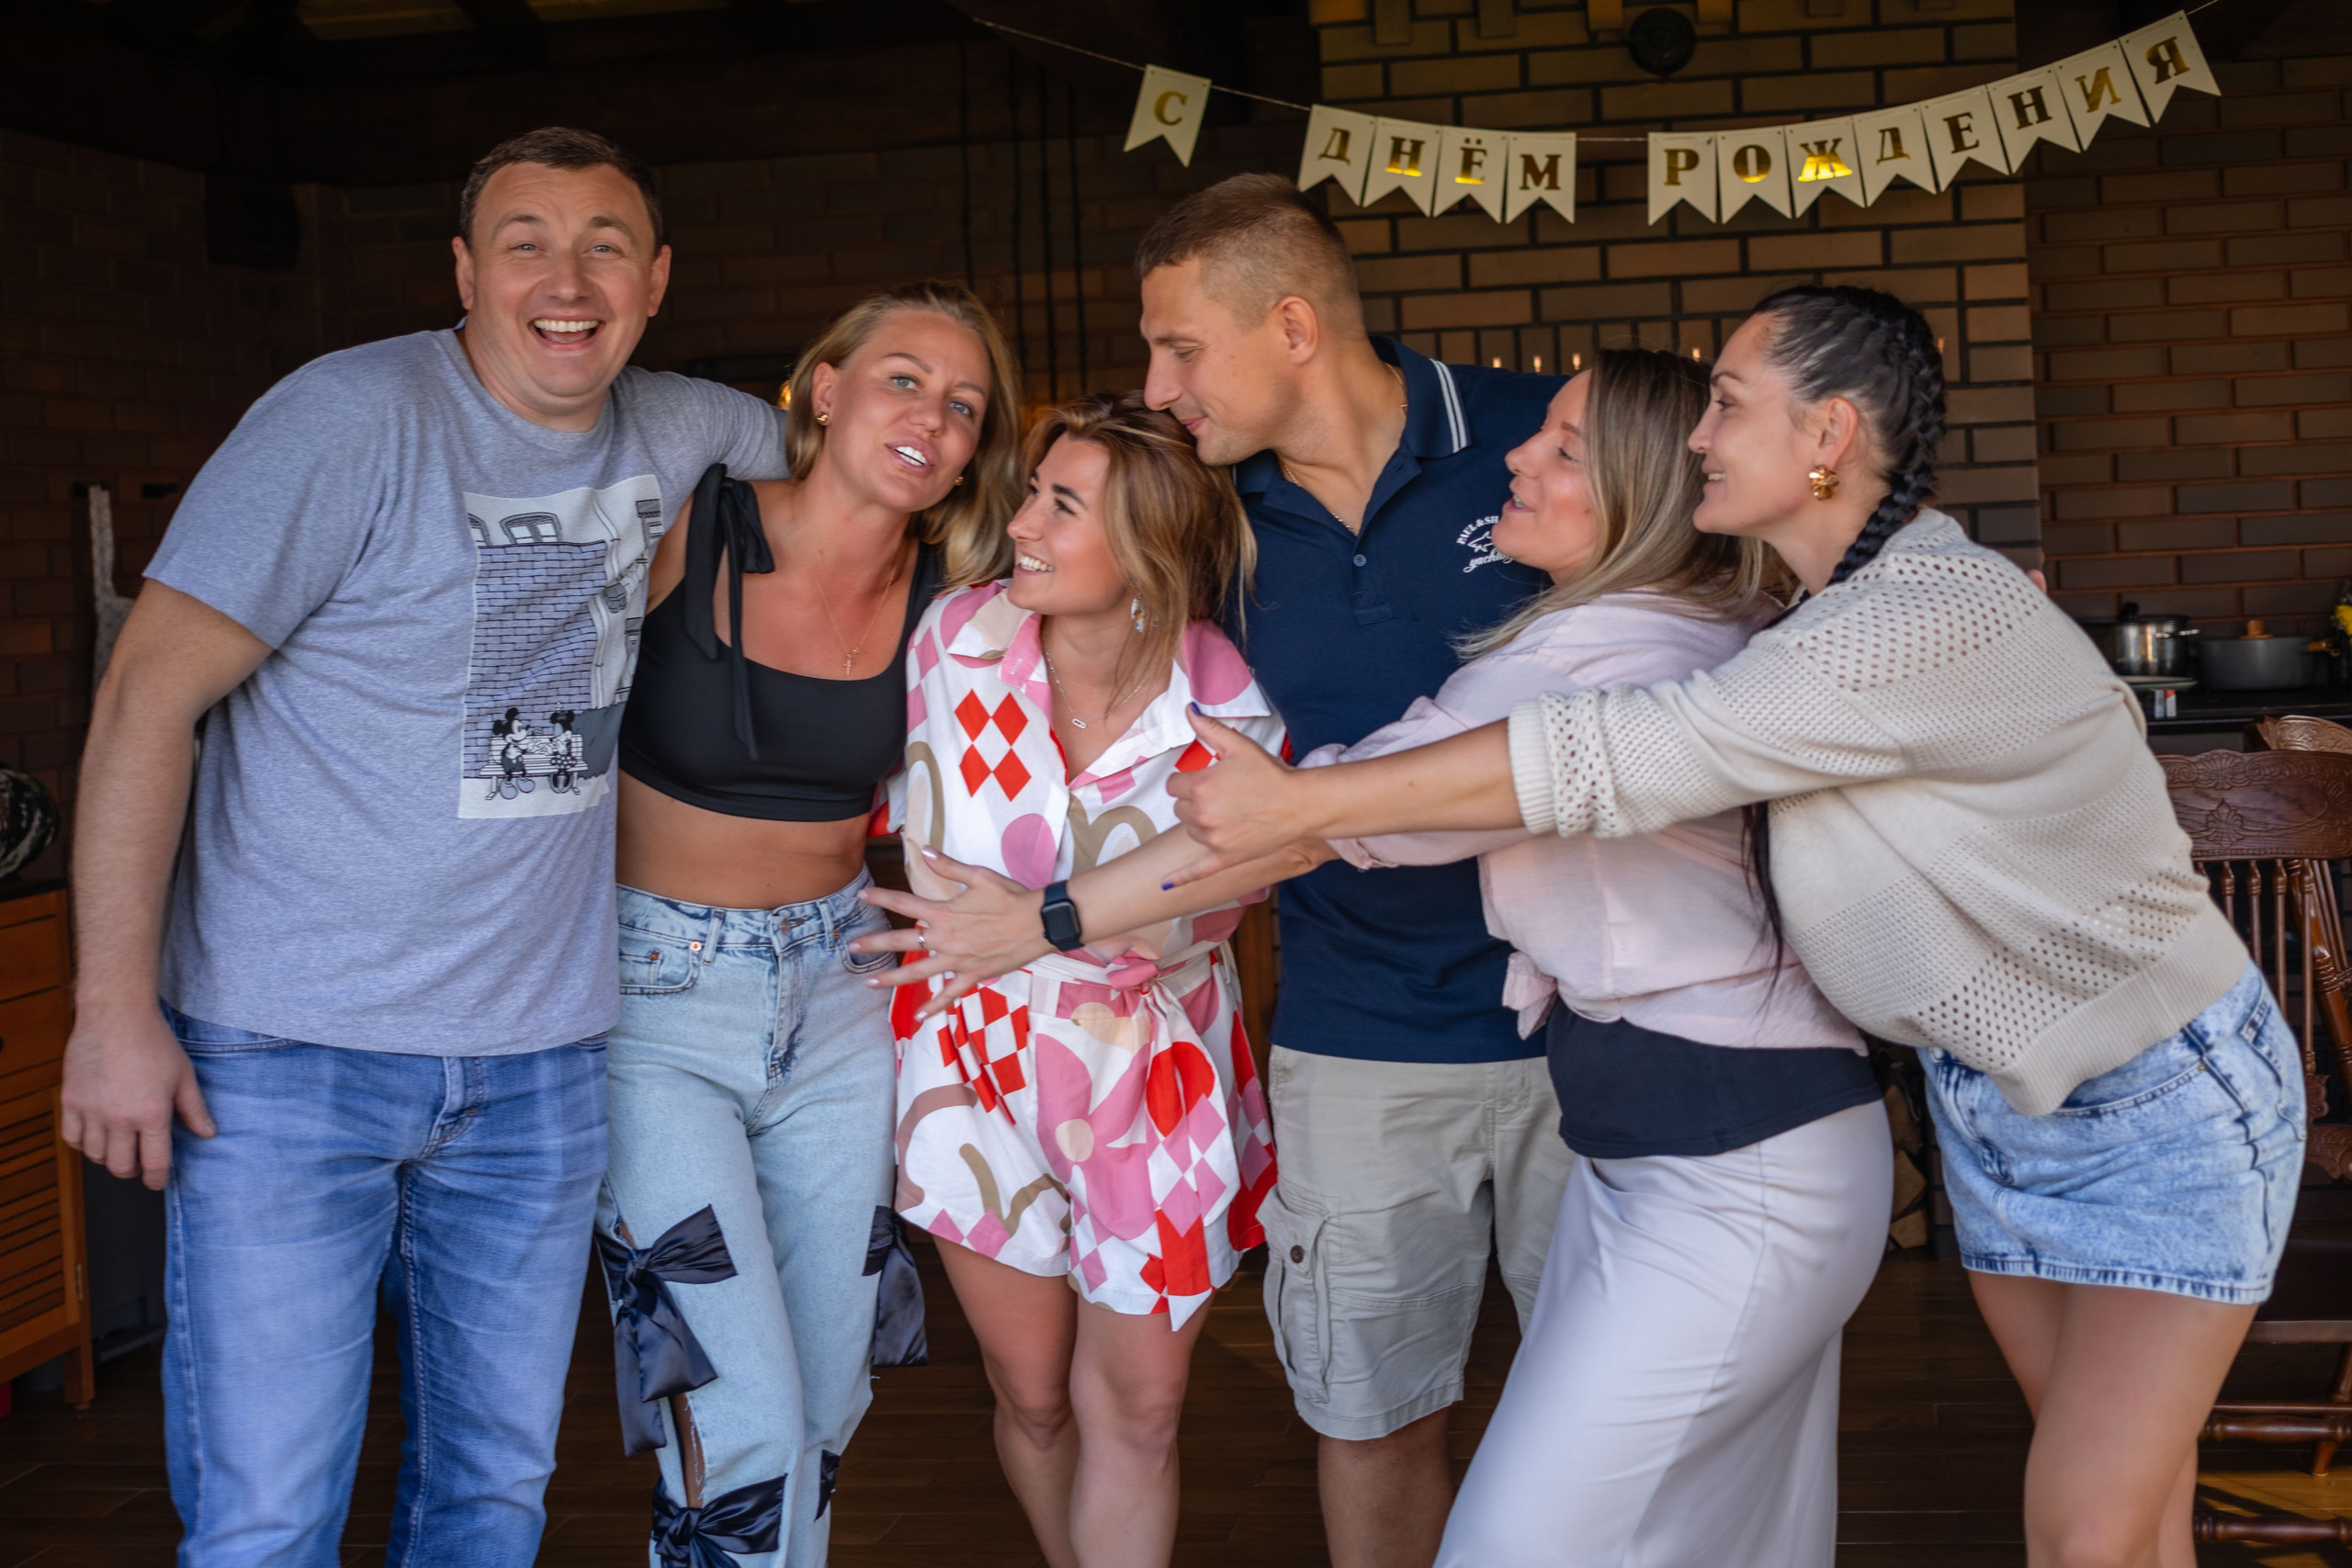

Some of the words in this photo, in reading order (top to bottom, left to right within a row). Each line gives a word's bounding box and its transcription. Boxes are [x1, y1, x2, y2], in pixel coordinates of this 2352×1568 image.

[1152, 90, 1189, 126] С
[1317, 127, 1562, 191] ДНЁМ
[1663, 35, 2191, 186] РОЖДЕНИЯ
